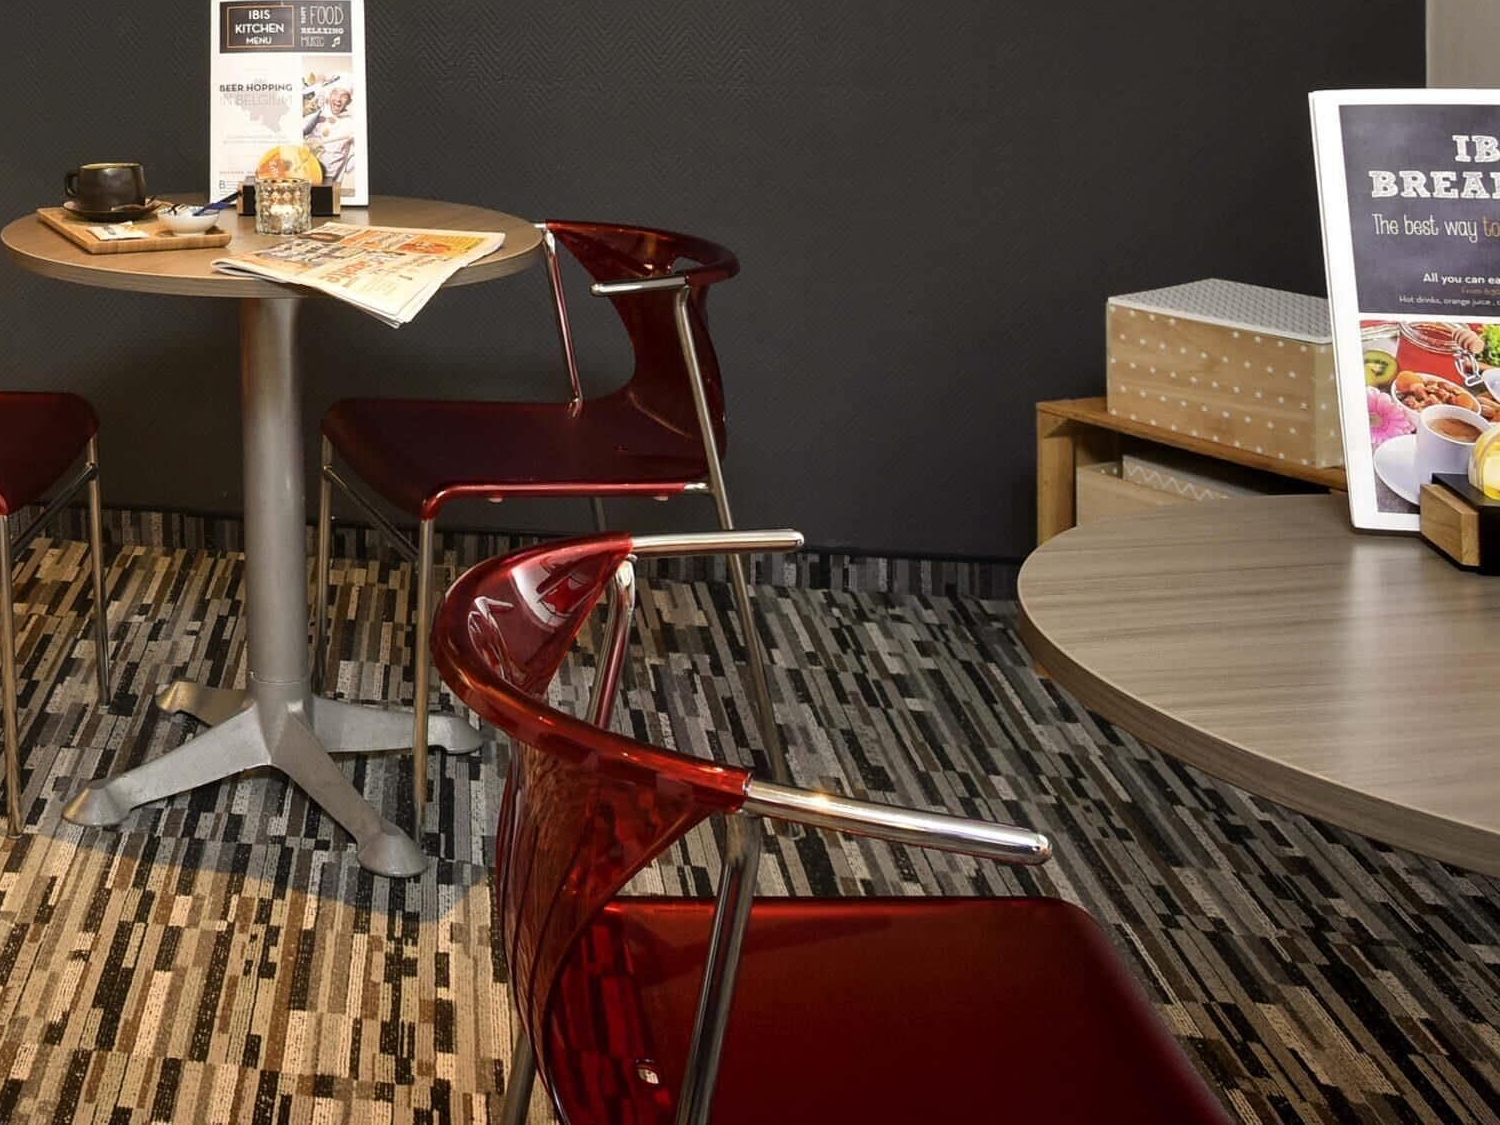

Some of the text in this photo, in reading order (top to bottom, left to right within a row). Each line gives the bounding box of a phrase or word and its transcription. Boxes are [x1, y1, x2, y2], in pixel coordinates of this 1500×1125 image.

[248, 9, 271, 20] IBIS
[309, 5, 344, 25] FOOD
[235, 23, 285, 34] KITCHEN
[246, 36, 272, 44] MENU
[220, 83, 293, 92] BEER HOPPING
[1452, 134, 1500, 163] IB
[1372, 213, 1500, 244] The best way to
[1423, 272, 1439, 283] All
[1440, 275, 1461, 286] you
[1464, 276, 1485, 284] can
[1399, 295, 1414, 303] Hot
[1443, 298, 1470, 307] orange
